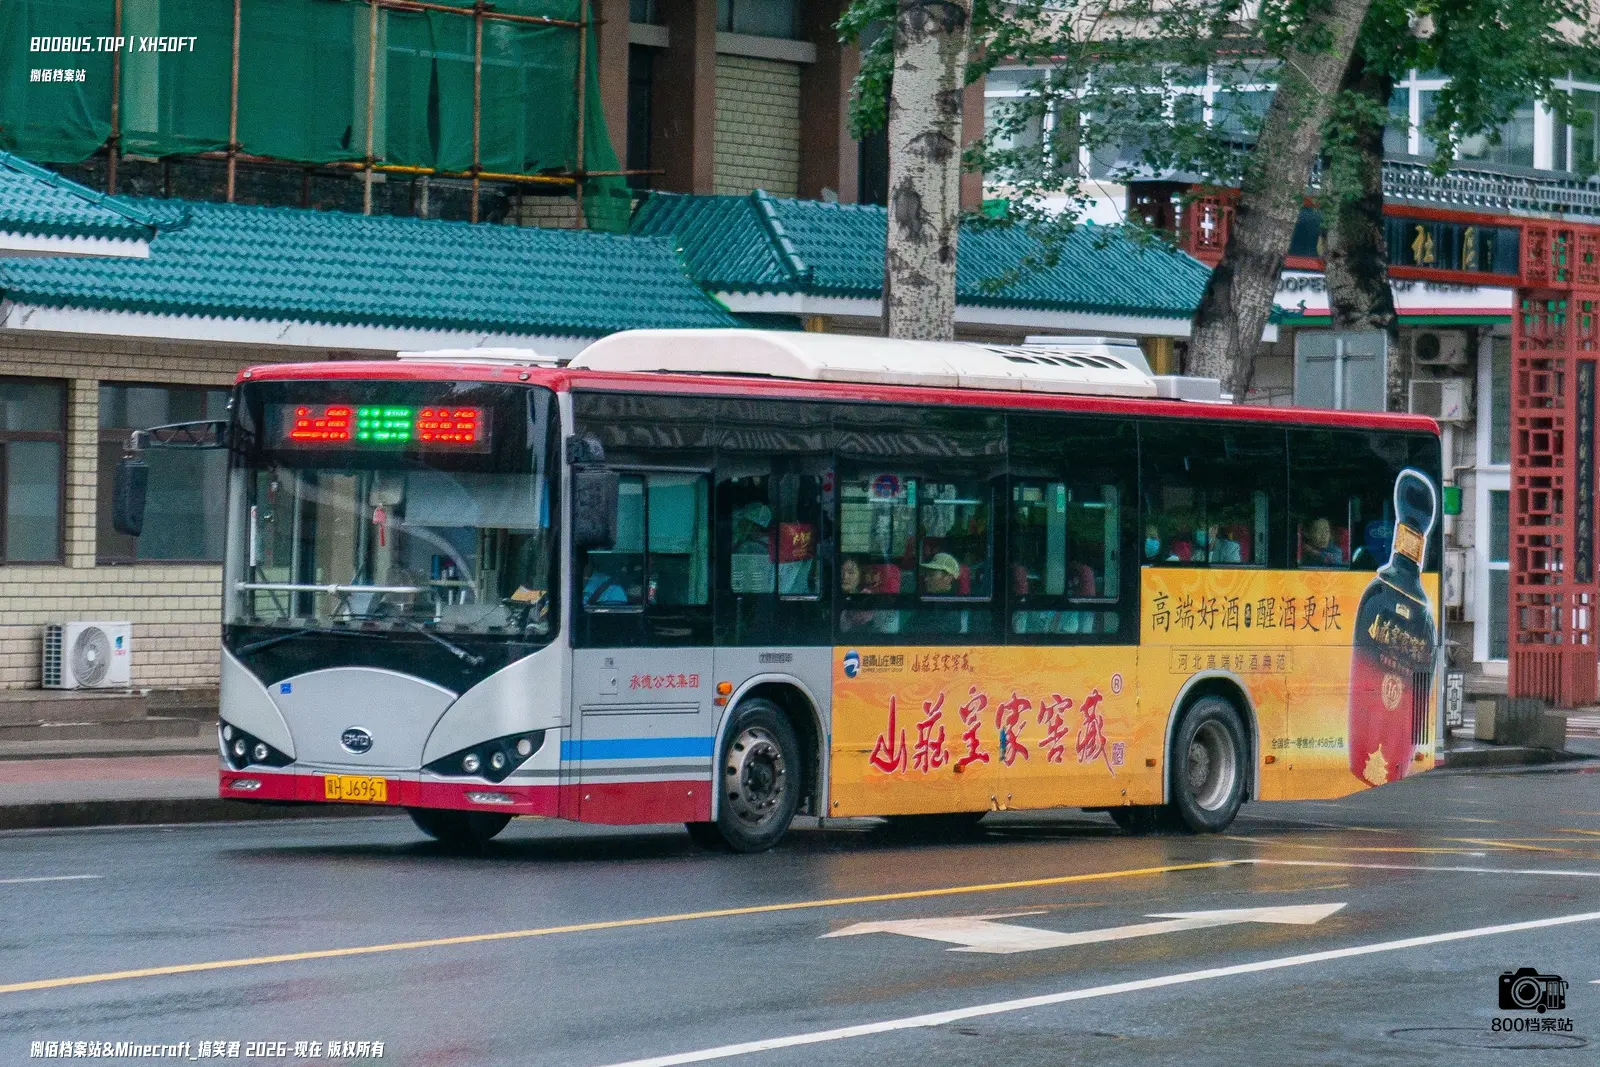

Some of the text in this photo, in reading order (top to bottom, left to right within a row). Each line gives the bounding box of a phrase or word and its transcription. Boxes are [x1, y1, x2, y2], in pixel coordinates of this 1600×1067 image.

[1151, 591, 1239, 633] 高端好酒
[1256, 596, 1342, 632] 醒酒更快
[629, 673, 700, 690] 承德公交集团
